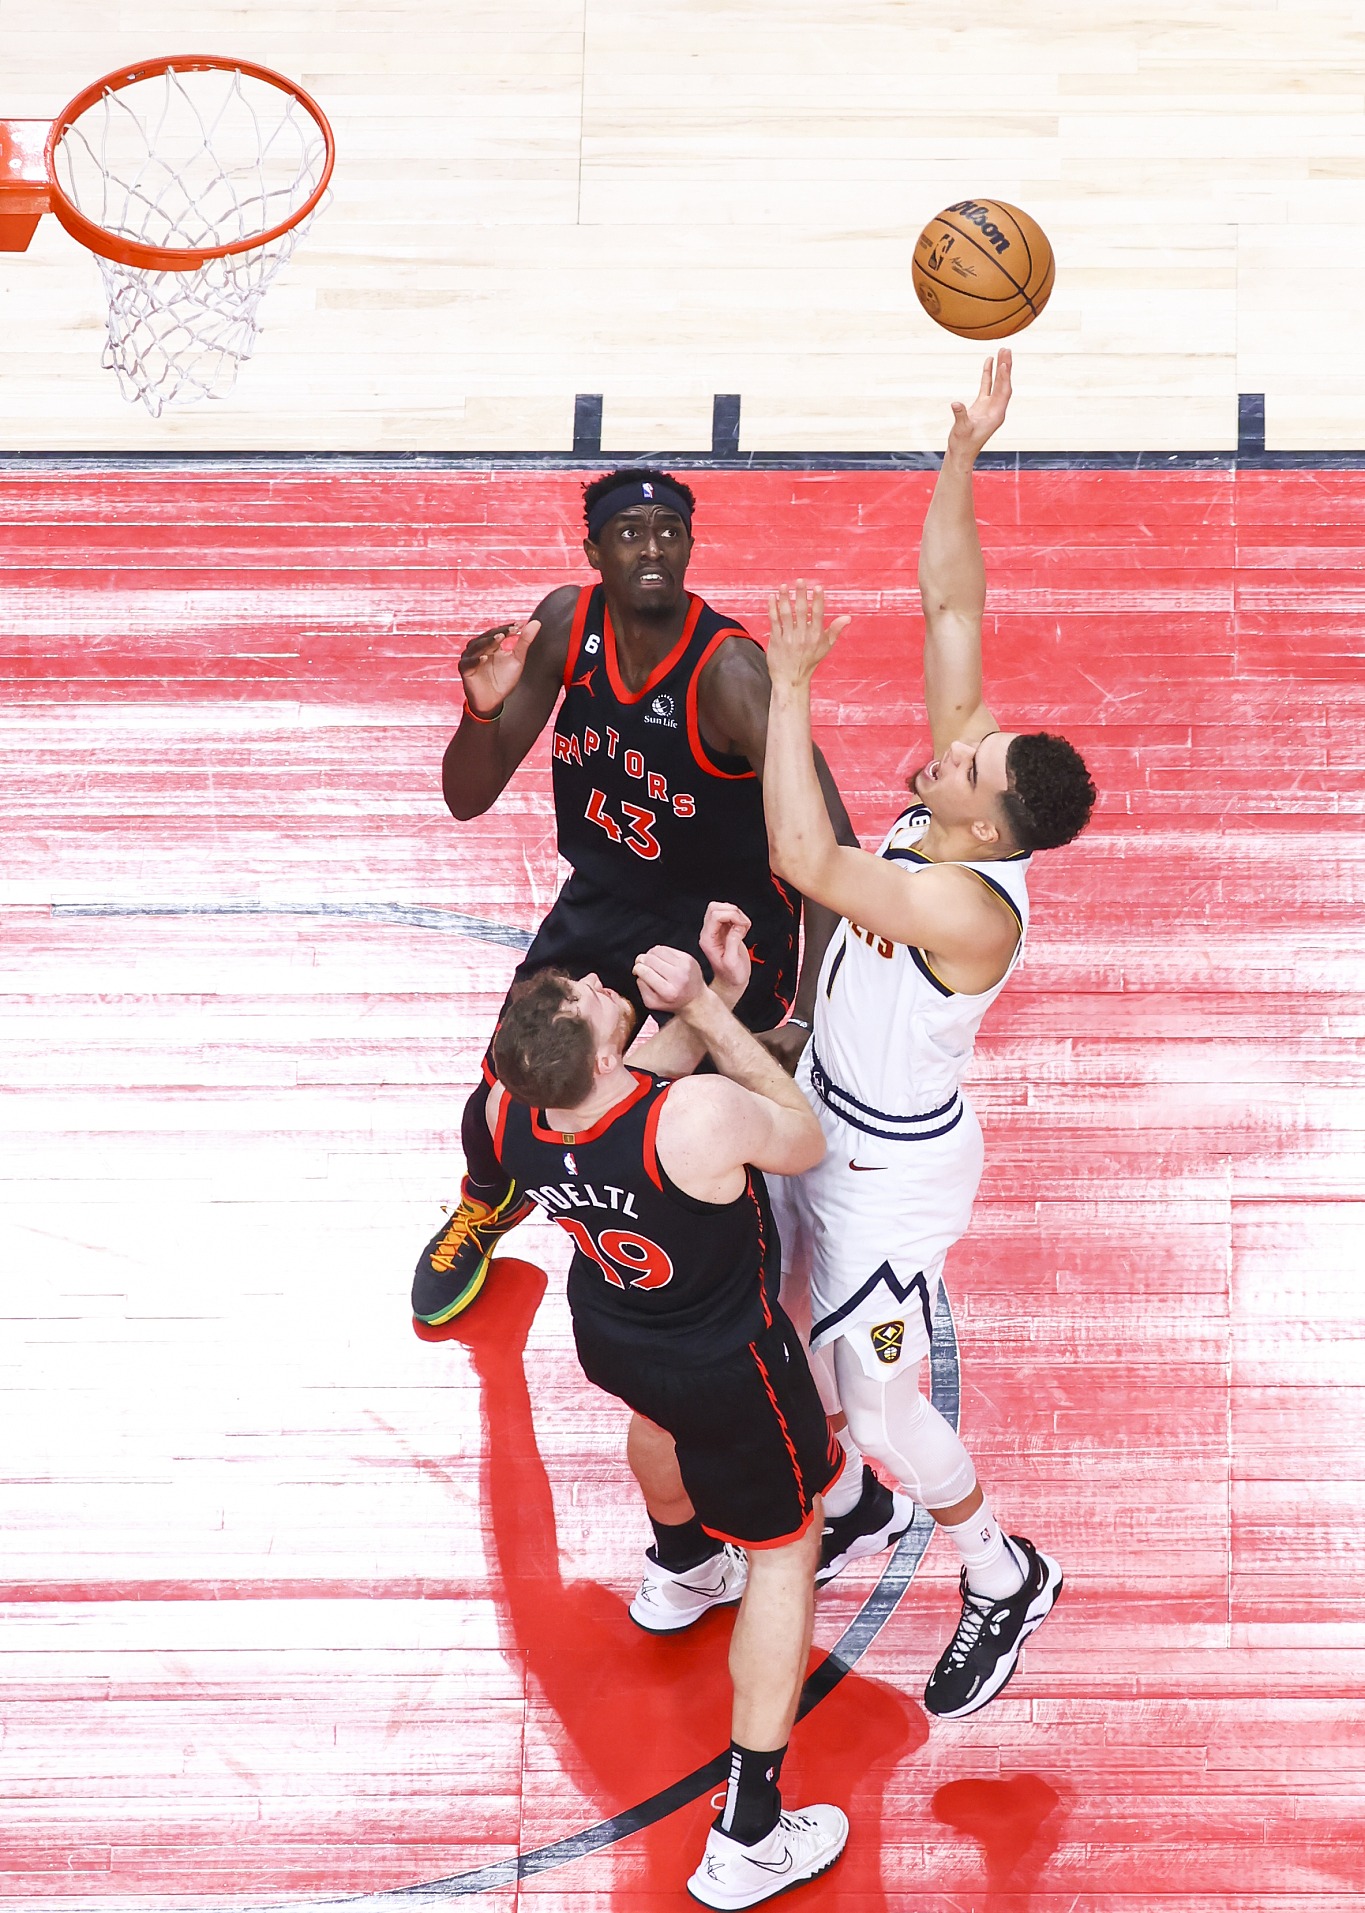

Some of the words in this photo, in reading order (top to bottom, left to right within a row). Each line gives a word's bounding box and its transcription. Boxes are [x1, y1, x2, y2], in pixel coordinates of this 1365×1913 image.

[584, 633, 600, 654] 6
[643, 715, 661, 724] Sun
[663, 718, 678, 728] Life
[553, 725, 696, 818] RAPTORS
[584, 787, 661, 861] 43
[524, 1183, 639, 1220] POELTL
[552, 1216, 674, 1291] 19
